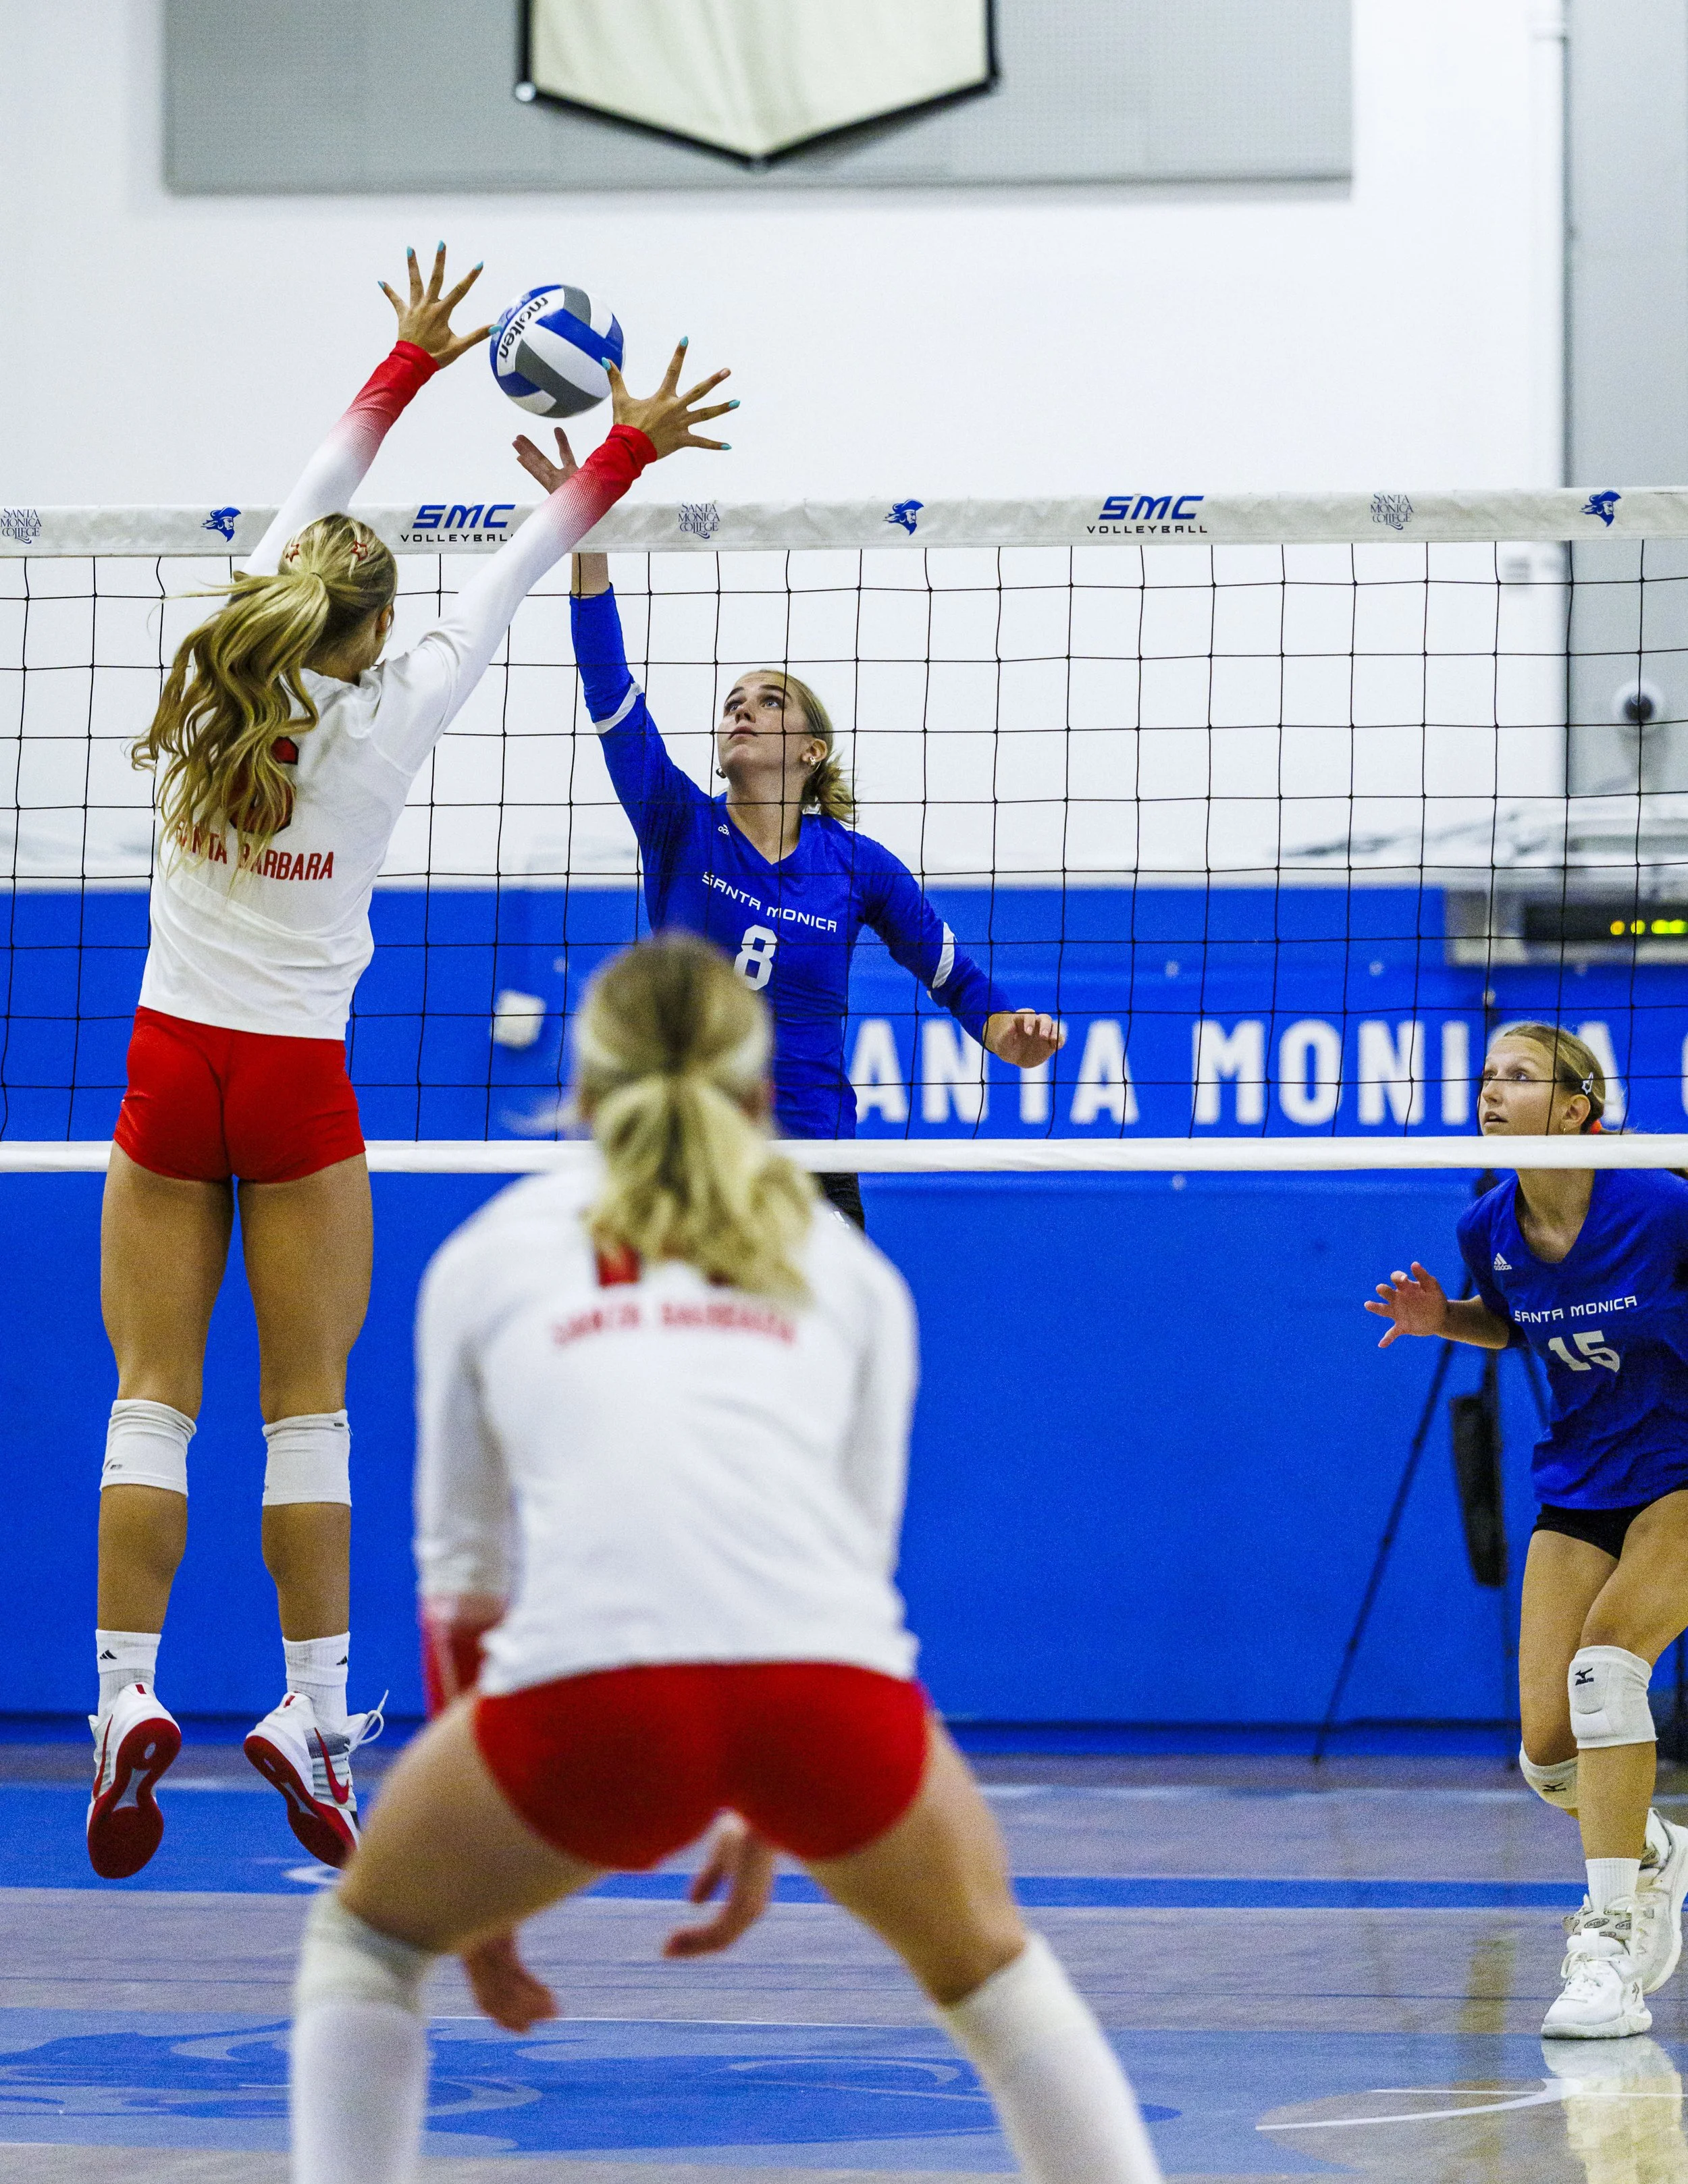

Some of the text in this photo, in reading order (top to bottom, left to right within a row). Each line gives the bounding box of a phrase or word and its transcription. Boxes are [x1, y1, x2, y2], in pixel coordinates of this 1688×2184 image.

[499, 297, 548, 363] molten
[1373, 493, 1410, 504] SANTA
[3, 508, 38, 518] SANTA
[681, 502, 717, 513] SANTA
[1099, 496, 1205, 521] SMC
[1370, 504, 1415, 513] MONICA
[0, 518, 42, 527] MONICA
[412, 504, 516, 529] SMC
[678, 512, 720, 523] MONICA
[1372, 513, 1413, 531] COLLEGE
[2, 527, 41, 544] COLLEGE
[400, 534, 513, 542] VOLLEYBAL
[679, 522, 719, 539] COLLEGE
[1086, 525, 1208, 534] VOLLEYBALL
[702, 872, 837, 932] SANTA MONICA
[734, 924, 777, 990] 8
[1191, 1018, 1627, 1126] MONIA
[1514, 1296, 1637, 1323] SANTA MONICA
[1548, 1330, 1620, 1373] 15
